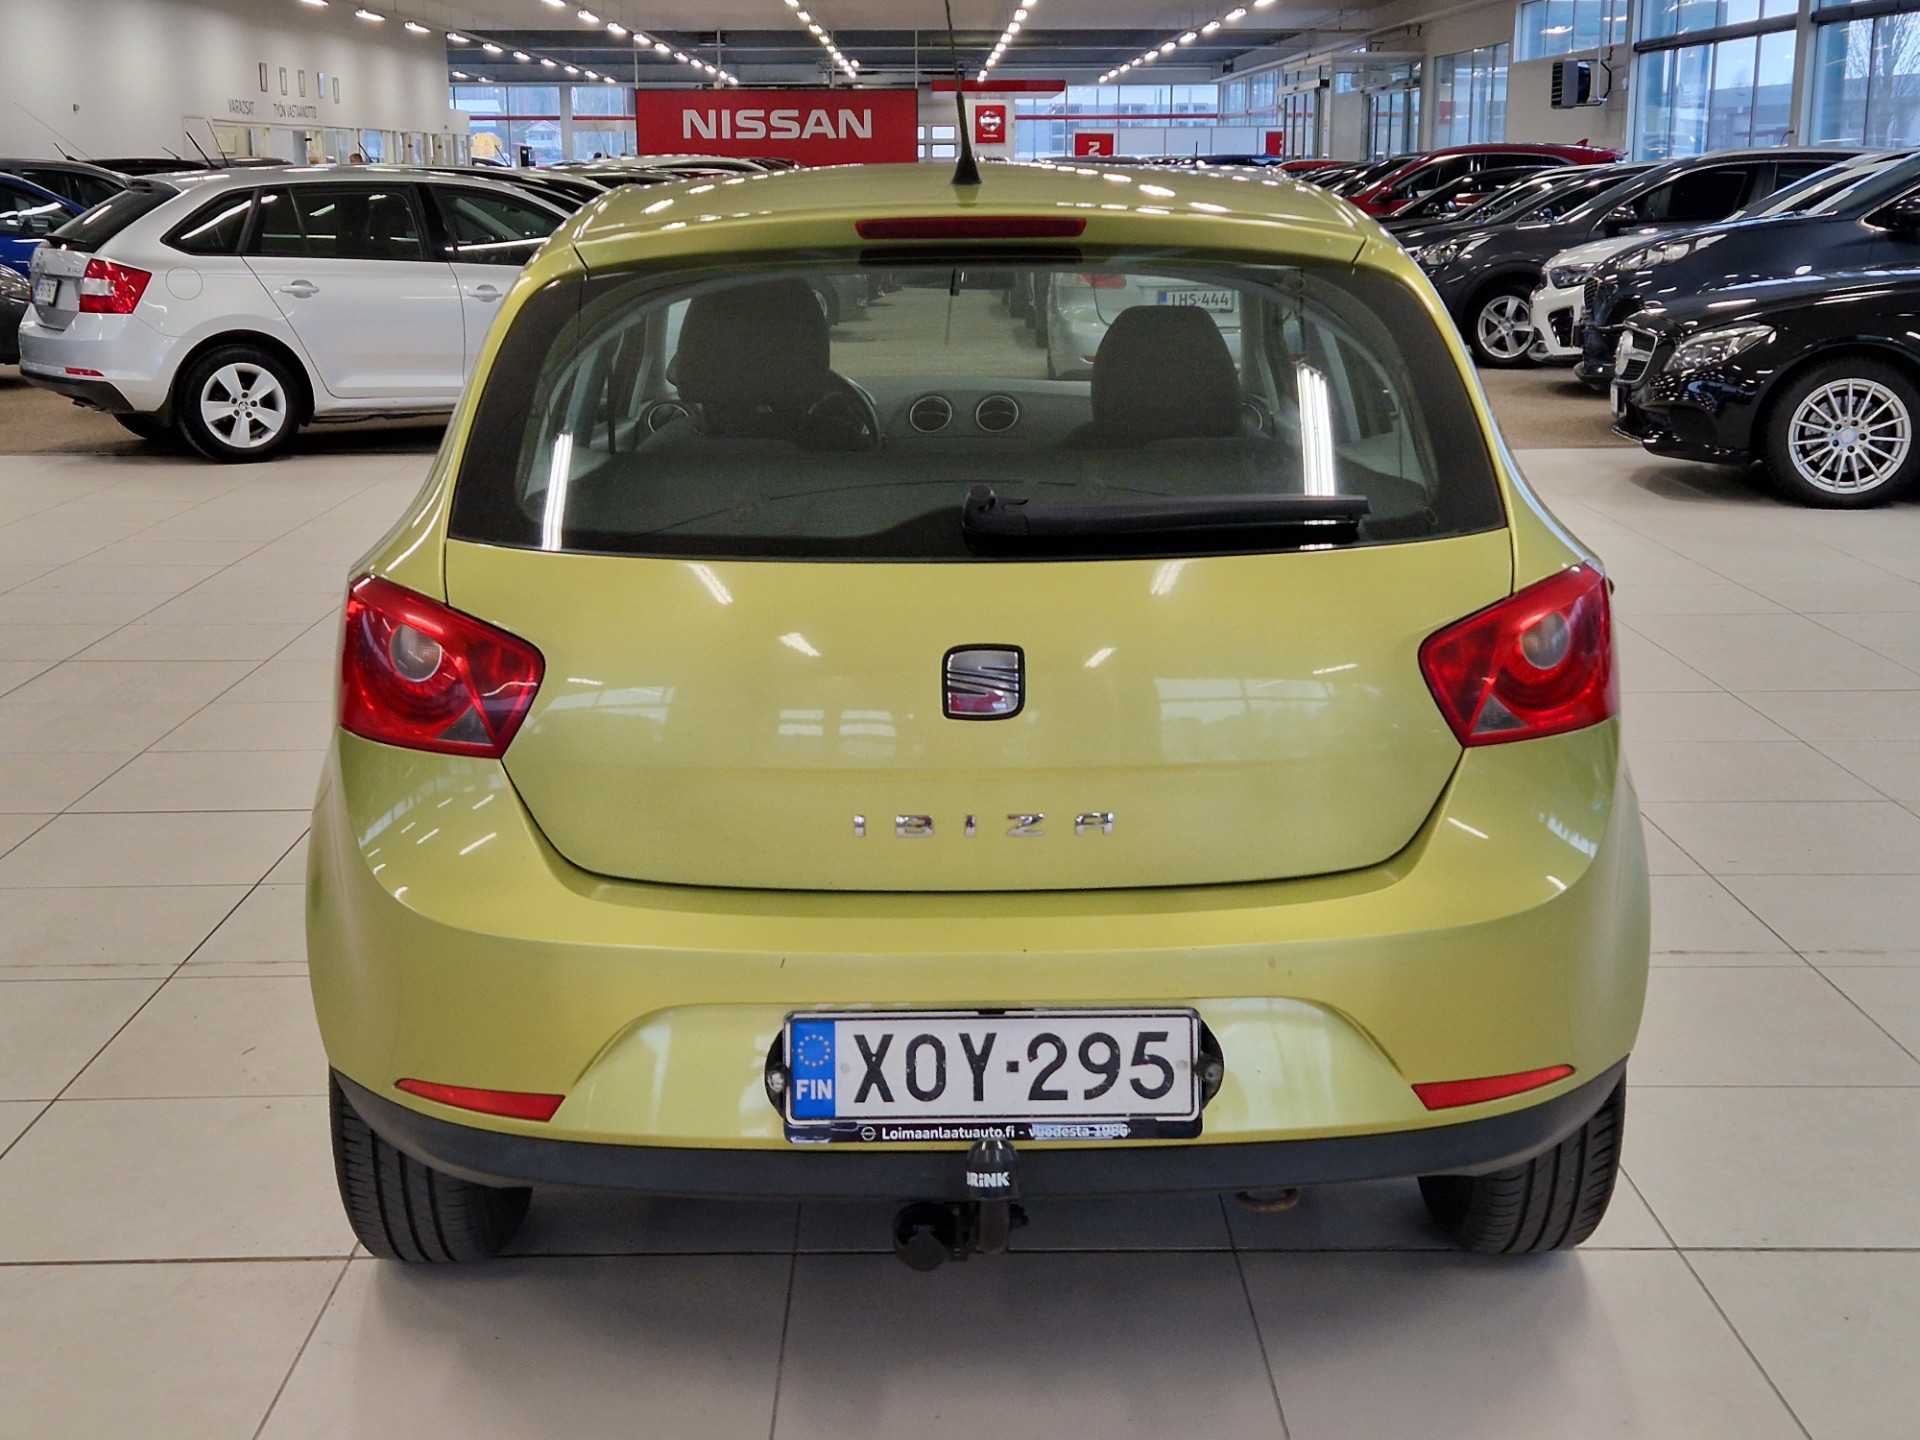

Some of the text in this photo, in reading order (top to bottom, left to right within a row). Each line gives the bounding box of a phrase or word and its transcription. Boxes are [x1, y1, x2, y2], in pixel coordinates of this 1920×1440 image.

[682, 109, 872, 139] NISSAN
[853, 811, 1116, 838] IBIZA
[853, 1031, 1175, 1103] XOY-295
[796, 1078, 833, 1101] FIN
[881, 1125, 1015, 1140] Loimaanlaatuauto.fi
